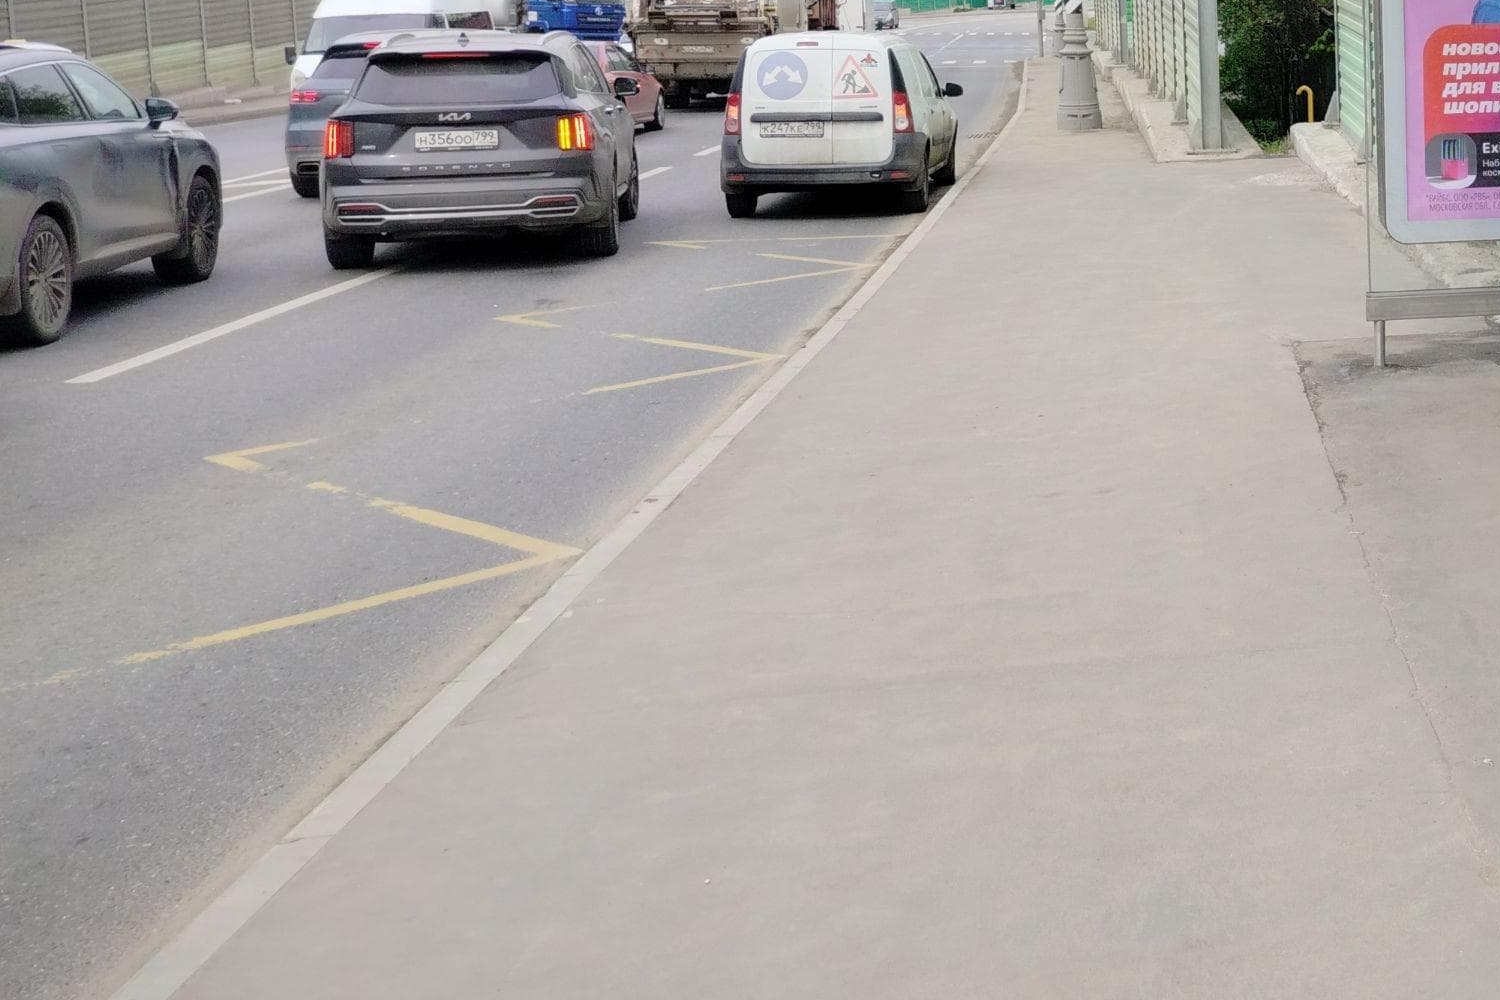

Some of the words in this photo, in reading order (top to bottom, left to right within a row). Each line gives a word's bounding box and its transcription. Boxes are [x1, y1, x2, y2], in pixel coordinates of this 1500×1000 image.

[1441, 81, 1486, 97] для
[474, 131, 495, 141] 799
[402, 163, 511, 172] SORENTO
